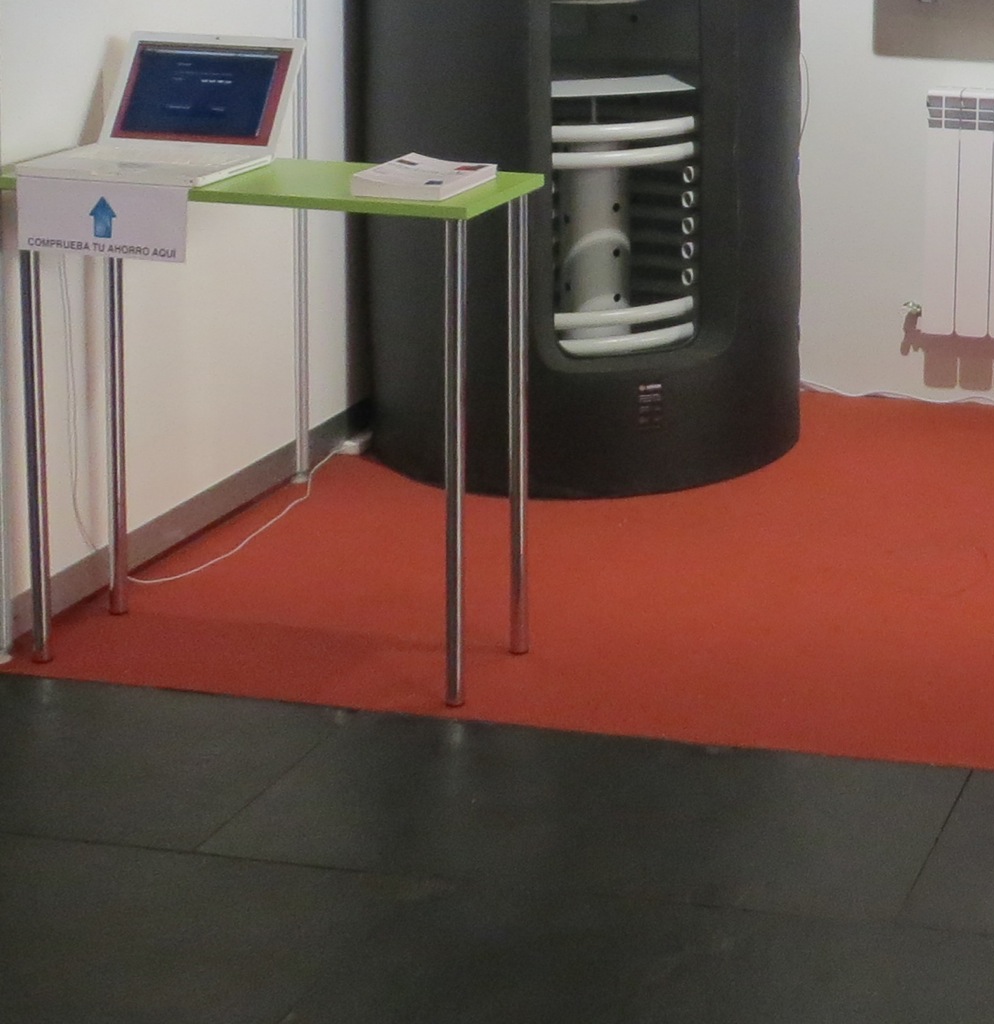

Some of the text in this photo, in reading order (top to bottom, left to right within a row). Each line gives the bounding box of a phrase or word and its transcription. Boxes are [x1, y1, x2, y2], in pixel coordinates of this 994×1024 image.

[27, 237, 90, 251] COMPRUEBA
[92, 242, 105, 253] TU
[107, 245, 150, 257] AHORRO
